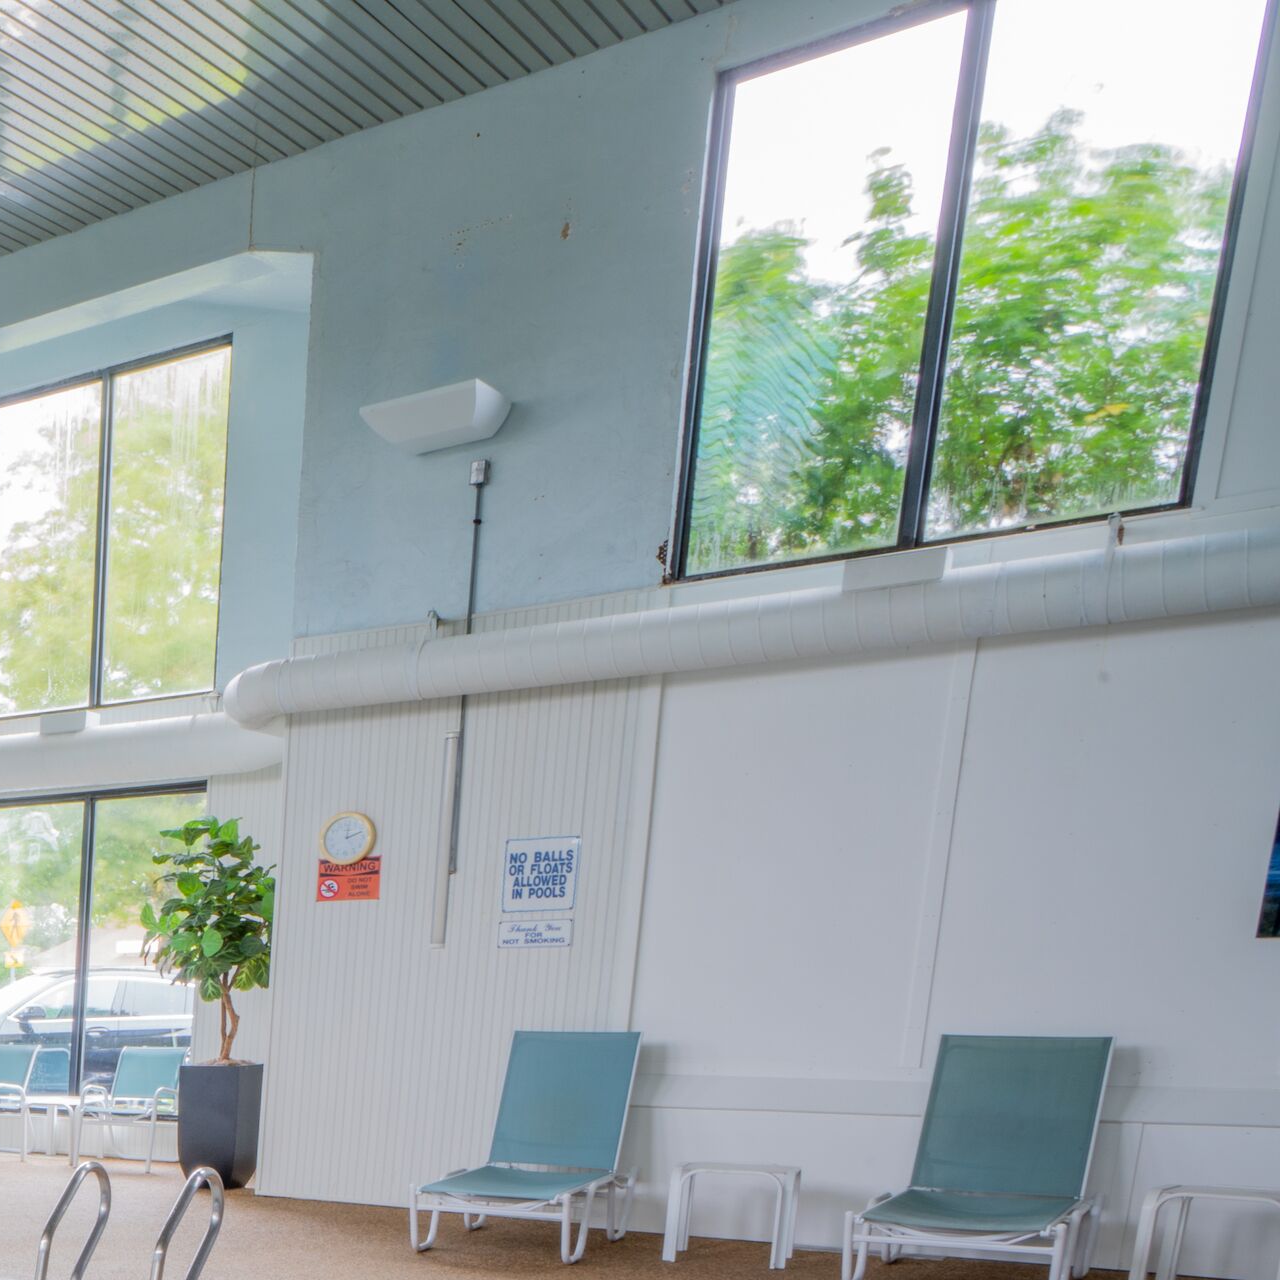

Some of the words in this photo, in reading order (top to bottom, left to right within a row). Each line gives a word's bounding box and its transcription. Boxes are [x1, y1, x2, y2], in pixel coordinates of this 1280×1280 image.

[510, 852, 527, 864] NO
[534, 850, 574, 863] BALLS
[324, 862, 376, 872] WARNING
[509, 865, 524, 876] OR
[530, 862, 573, 875] FLOATS
[513, 875, 567, 888] ALLOWED
[511, 889, 523, 900] IN
[528, 887, 566, 899] POOLS
[507, 923, 538, 932] Thank
